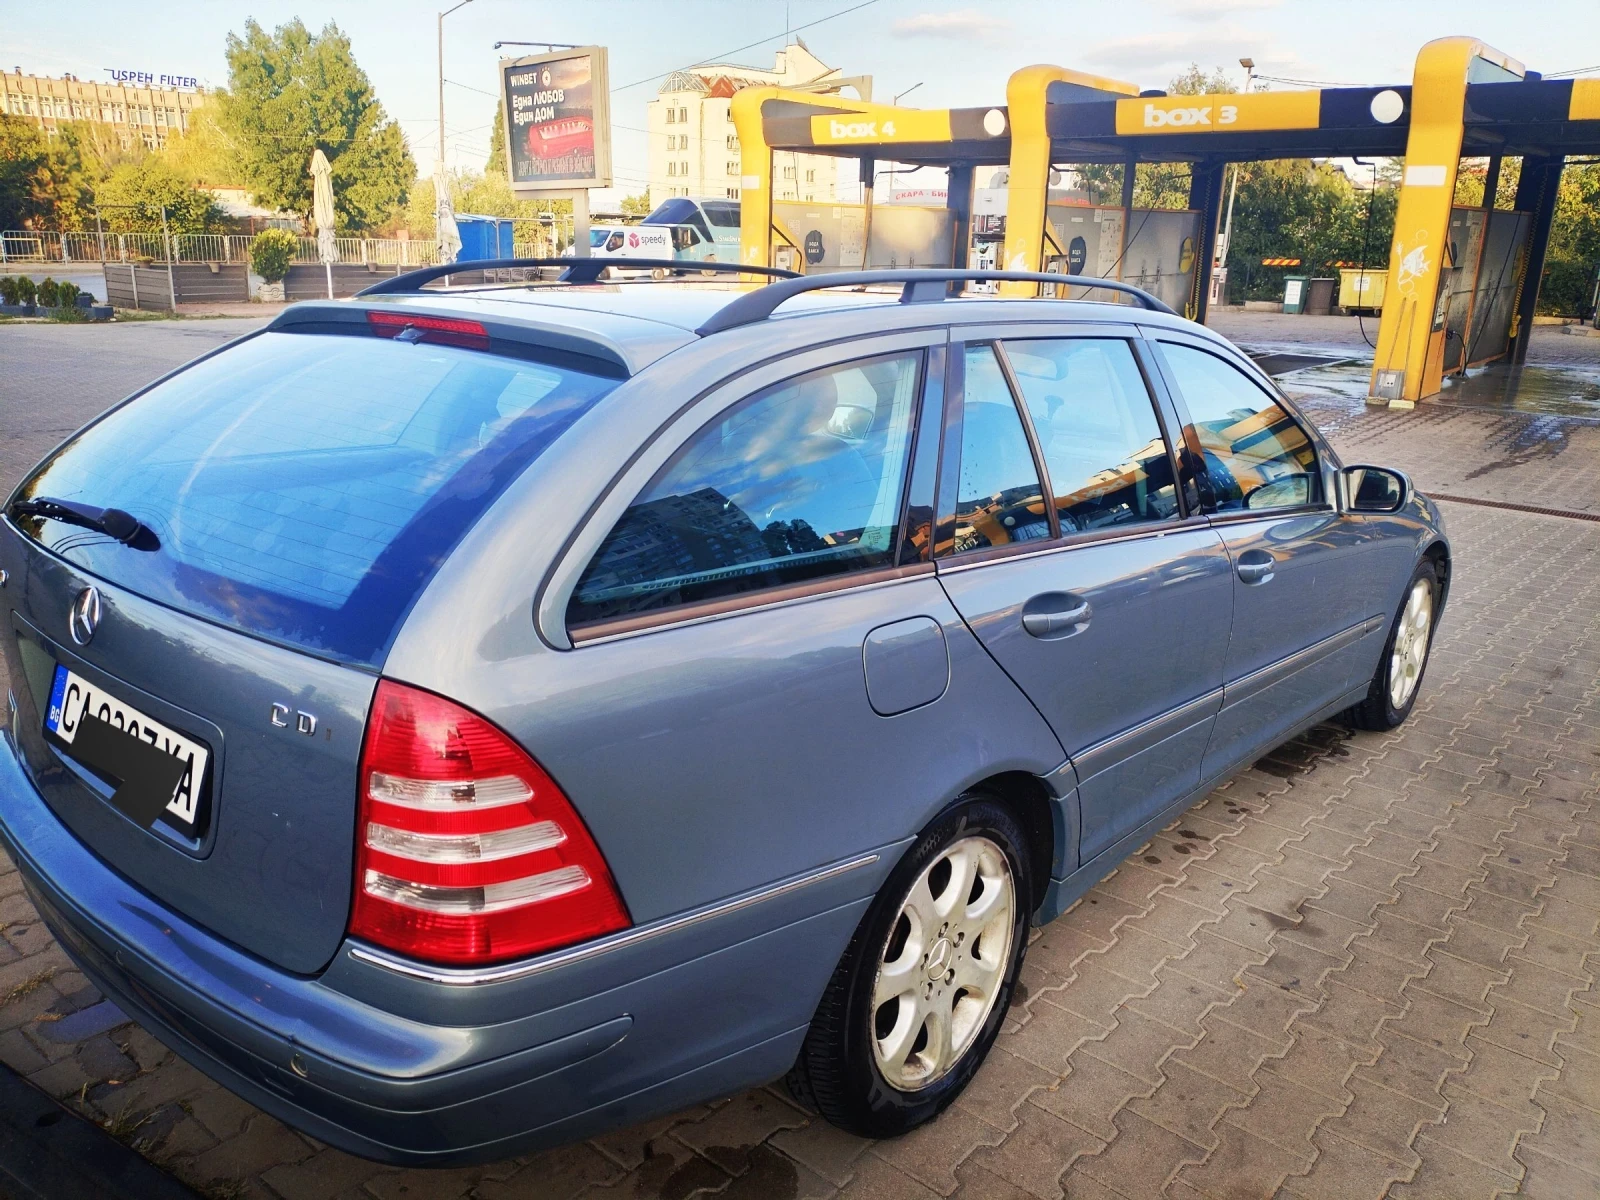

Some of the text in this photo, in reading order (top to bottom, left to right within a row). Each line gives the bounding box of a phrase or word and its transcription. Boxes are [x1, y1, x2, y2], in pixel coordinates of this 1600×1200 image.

[111, 69, 197, 87] USPEH FILTER
[510, 72, 537, 87] WINBET
[512, 89, 565, 110] Една ЛЮБОВ
[513, 106, 555, 126] Един ДОМ
[1144, 103, 1238, 127] box 3
[829, 119, 896, 139] box 4
[895, 190, 924, 200] СКАРА
[641, 234, 666, 246] speedy
[50, 705, 60, 723] BG
